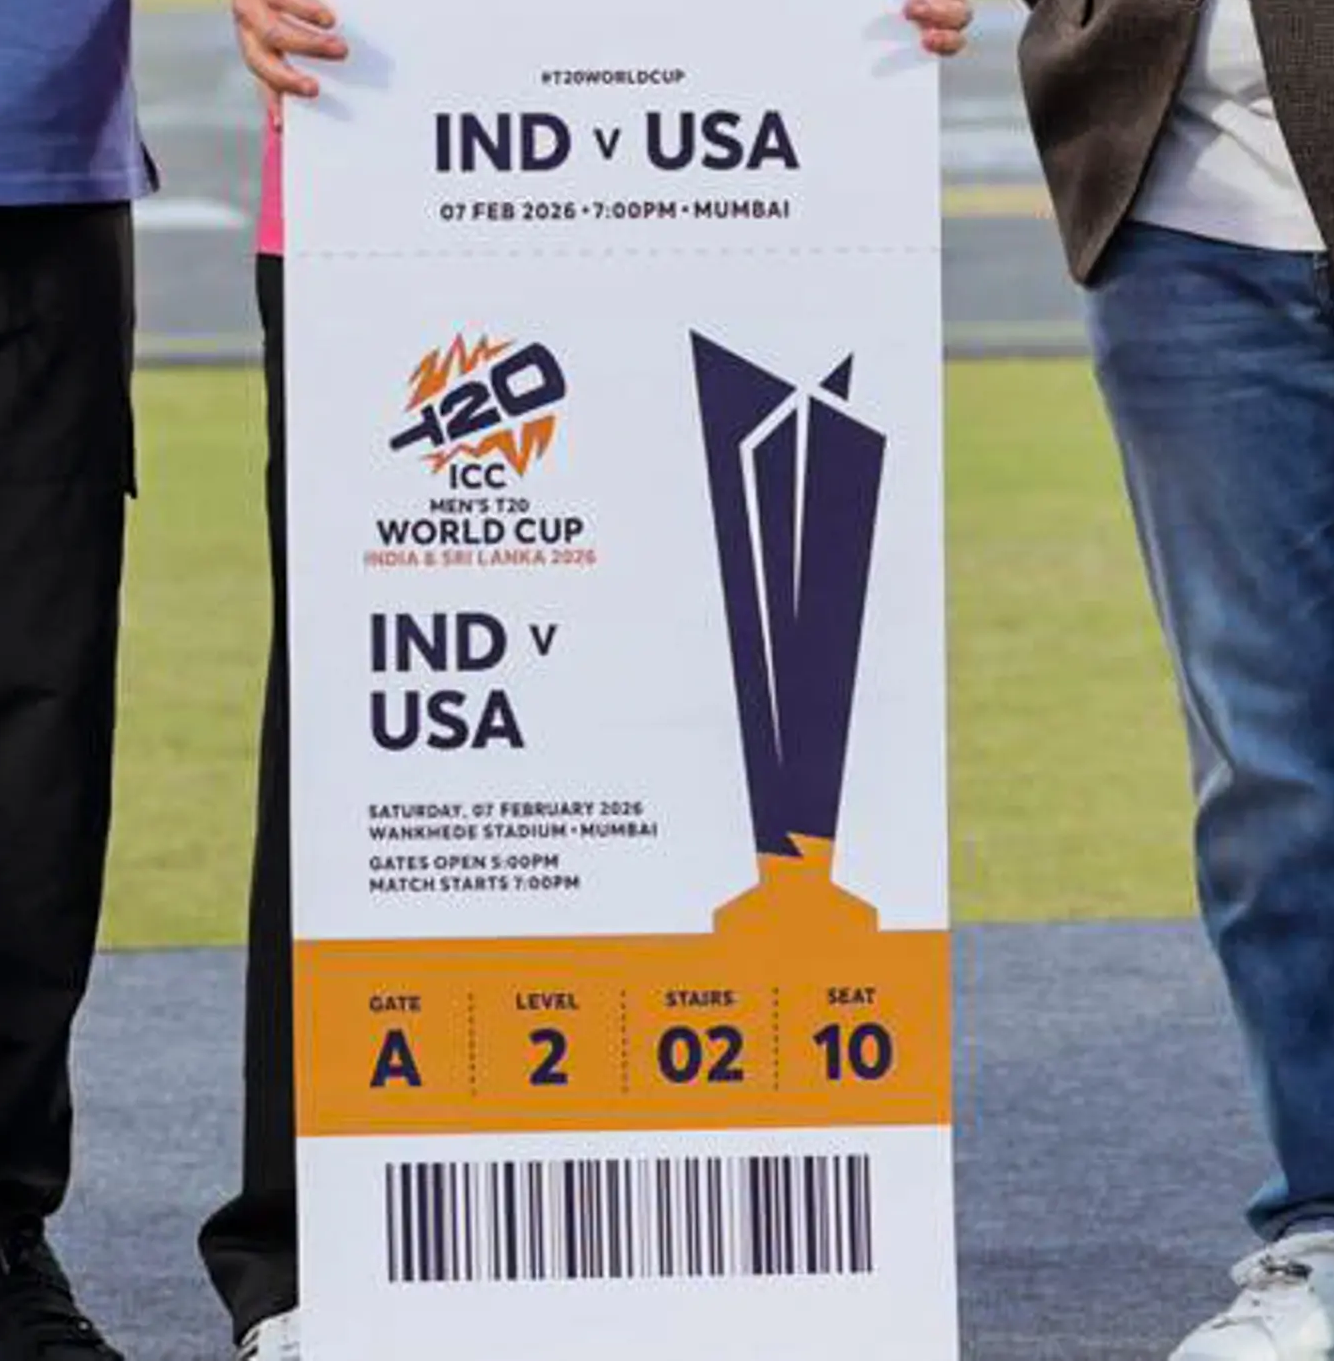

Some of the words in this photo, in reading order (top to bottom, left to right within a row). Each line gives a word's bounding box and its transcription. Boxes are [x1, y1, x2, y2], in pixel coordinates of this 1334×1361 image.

[541, 68, 686, 86] #T20WORLDCUP
[435, 112, 572, 173] IND
[645, 109, 800, 171] USA
[439, 202, 467, 222] 07
[471, 201, 516, 222] FEB
[522, 201, 577, 221] 2026
[592, 200, 677, 220] 7:00PM
[693, 199, 790, 219] MUMBAI
[390, 341, 566, 451] T20
[449, 462, 507, 491] ICC
[429, 497, 490, 514] MEN'S
[495, 497, 530, 514] T20
[376, 517, 506, 547] WORLD
[513, 516, 584, 545] CUP
[363, 549, 420, 567] INDIA
[441, 548, 473, 567] SRI
[477, 548, 547, 567] LANKA
[550, 548, 597, 565] 2026
[370, 611, 508, 673] IND
[370, 689, 525, 752] USA
[368, 803, 468, 821] SATURDAY,
[471, 802, 495, 819] 07
[499, 801, 595, 818] FEBRUARY
[599, 800, 644, 816] 2026
[368, 824, 477, 841] WANKHEDE
[482, 823, 567, 840] STADIUM
[579, 821, 658, 838] MUMBAI
[368, 855, 430, 872] GATES
[433, 854, 487, 871] OPEN
[490, 853, 559, 870] 5:00PM
[368, 876, 436, 893] MATCH
[439, 875, 509, 893] STARTS
[513, 874, 581, 891] 7:00PM
[368, 994, 422, 1014] GATE
[515, 992, 579, 1011] LEVEL
[664, 989, 737, 1008] STAIRS
[827, 986, 876, 1005] SEAT
[369, 1028, 422, 1088] A
[528, 1027, 569, 1087] 2
[656, 1024, 744, 1084] 02
[812, 1022, 893, 1081] 10
